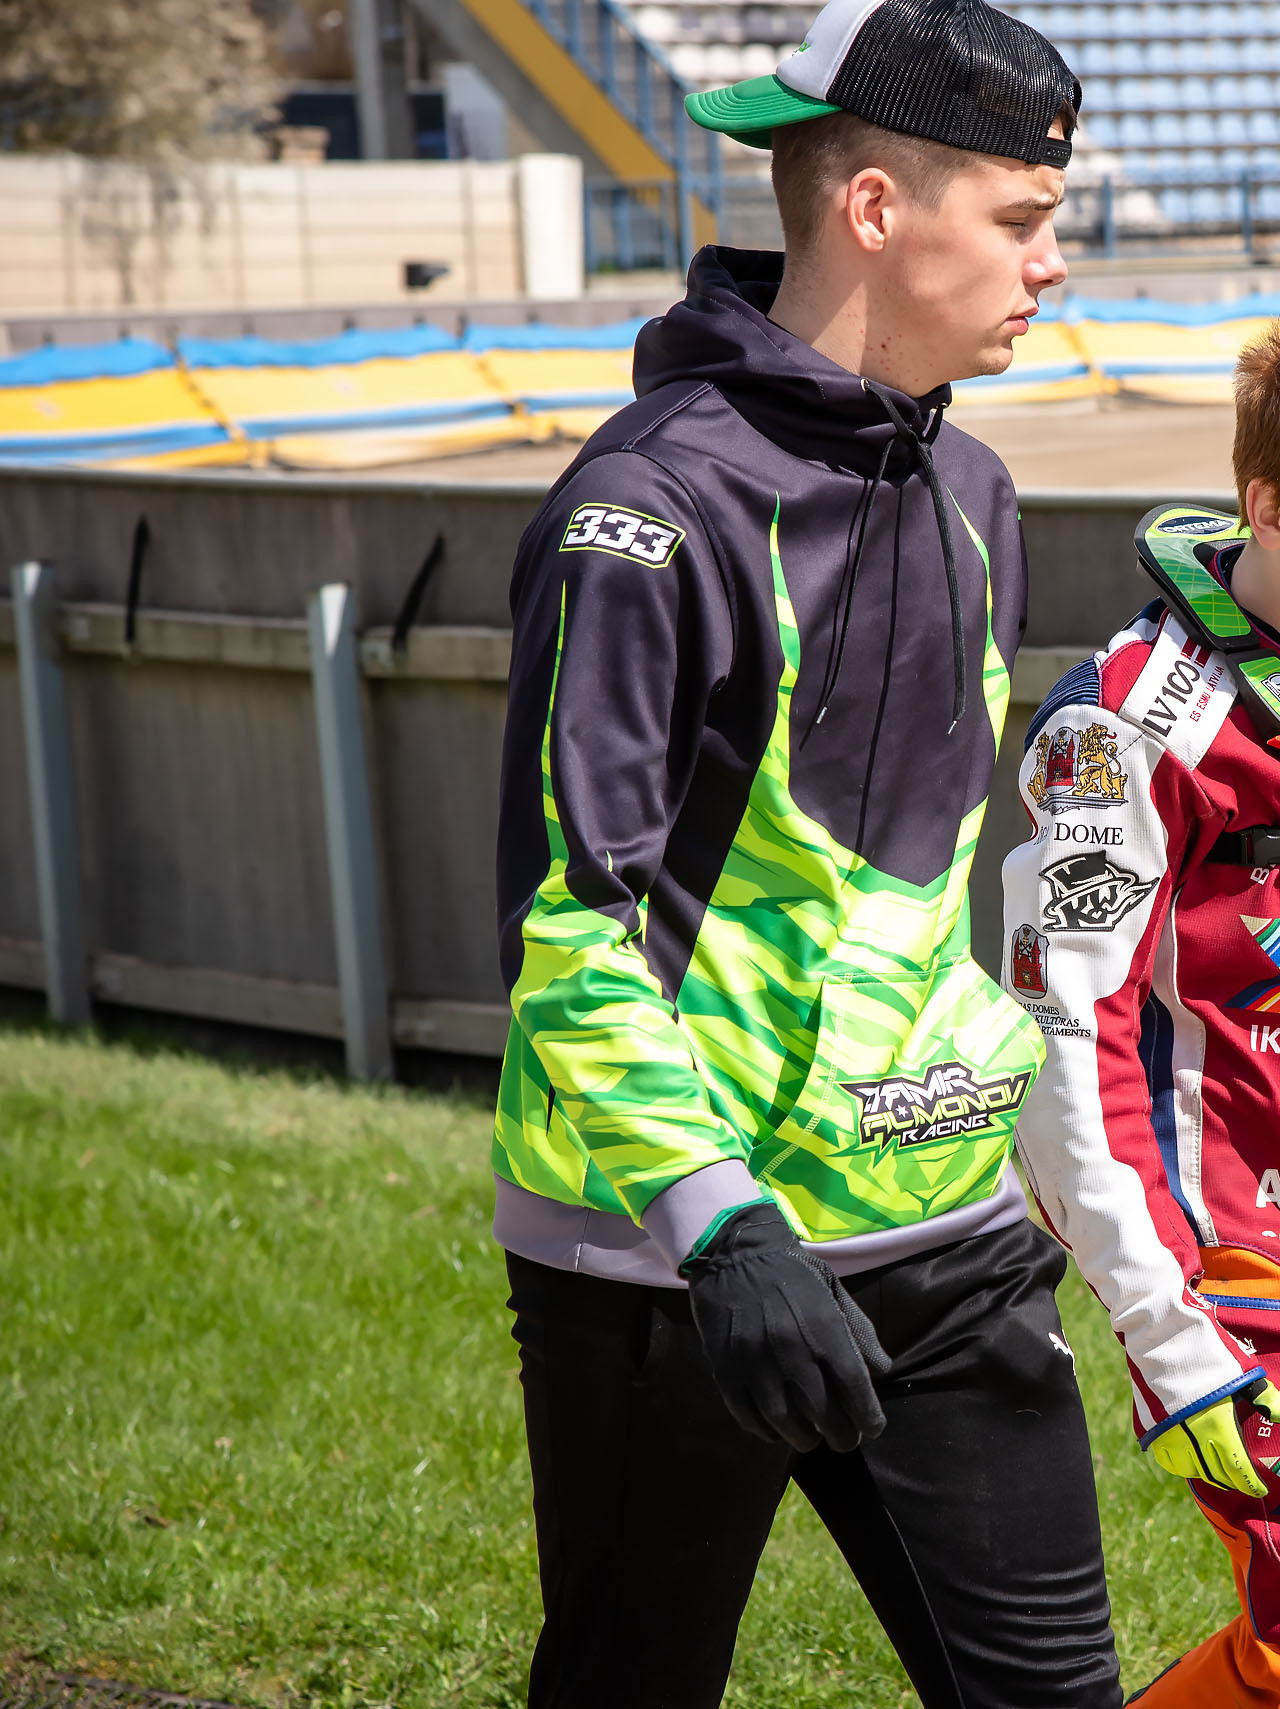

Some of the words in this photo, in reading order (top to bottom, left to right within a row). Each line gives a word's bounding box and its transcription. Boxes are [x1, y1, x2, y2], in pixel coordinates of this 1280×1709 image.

[564, 508, 678, 563] 333
[1162, 519, 1232, 534] ORTEMA
[1190, 710, 1202, 722] ES
[1205, 665, 1225, 692] LATVIJA
[1053, 822, 1125, 846] DOME
[1032, 1003, 1060, 1016] DOMES
[901, 1113, 989, 1144] RACING
